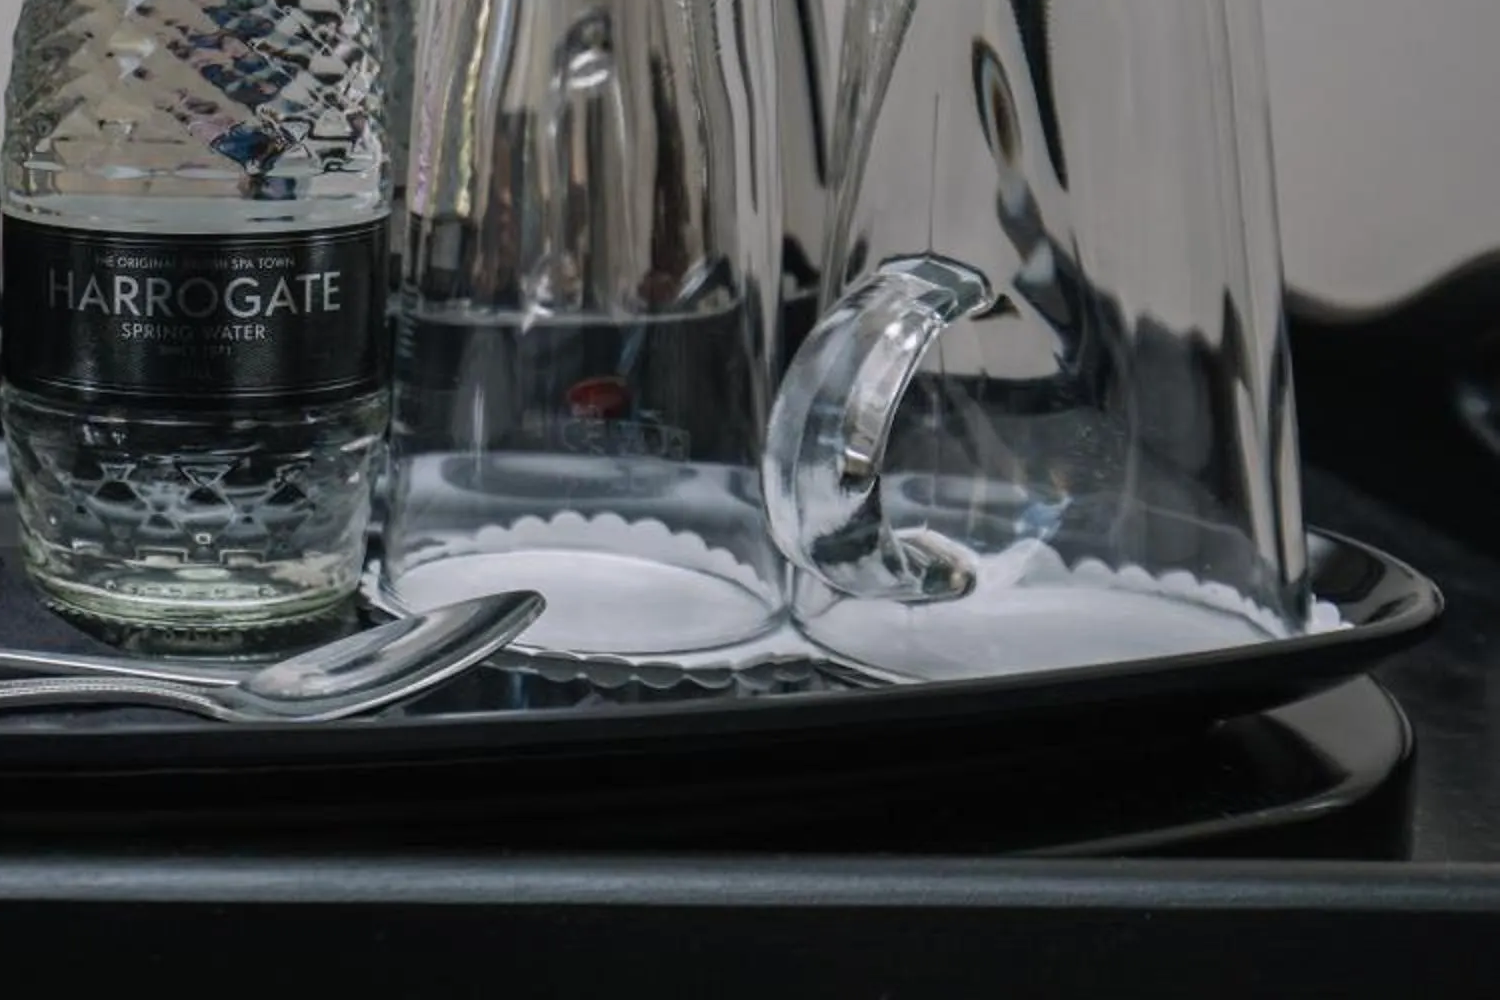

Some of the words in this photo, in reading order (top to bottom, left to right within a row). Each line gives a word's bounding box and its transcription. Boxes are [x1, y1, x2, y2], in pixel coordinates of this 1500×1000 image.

[116, 255, 176, 269] ORIGINAL
[230, 256, 255, 270] SPA
[258, 256, 296, 270] TOWN
[49, 267, 342, 318] HARROGATE
[120, 322, 195, 341] SPRING
[203, 323, 267, 342] WATER
